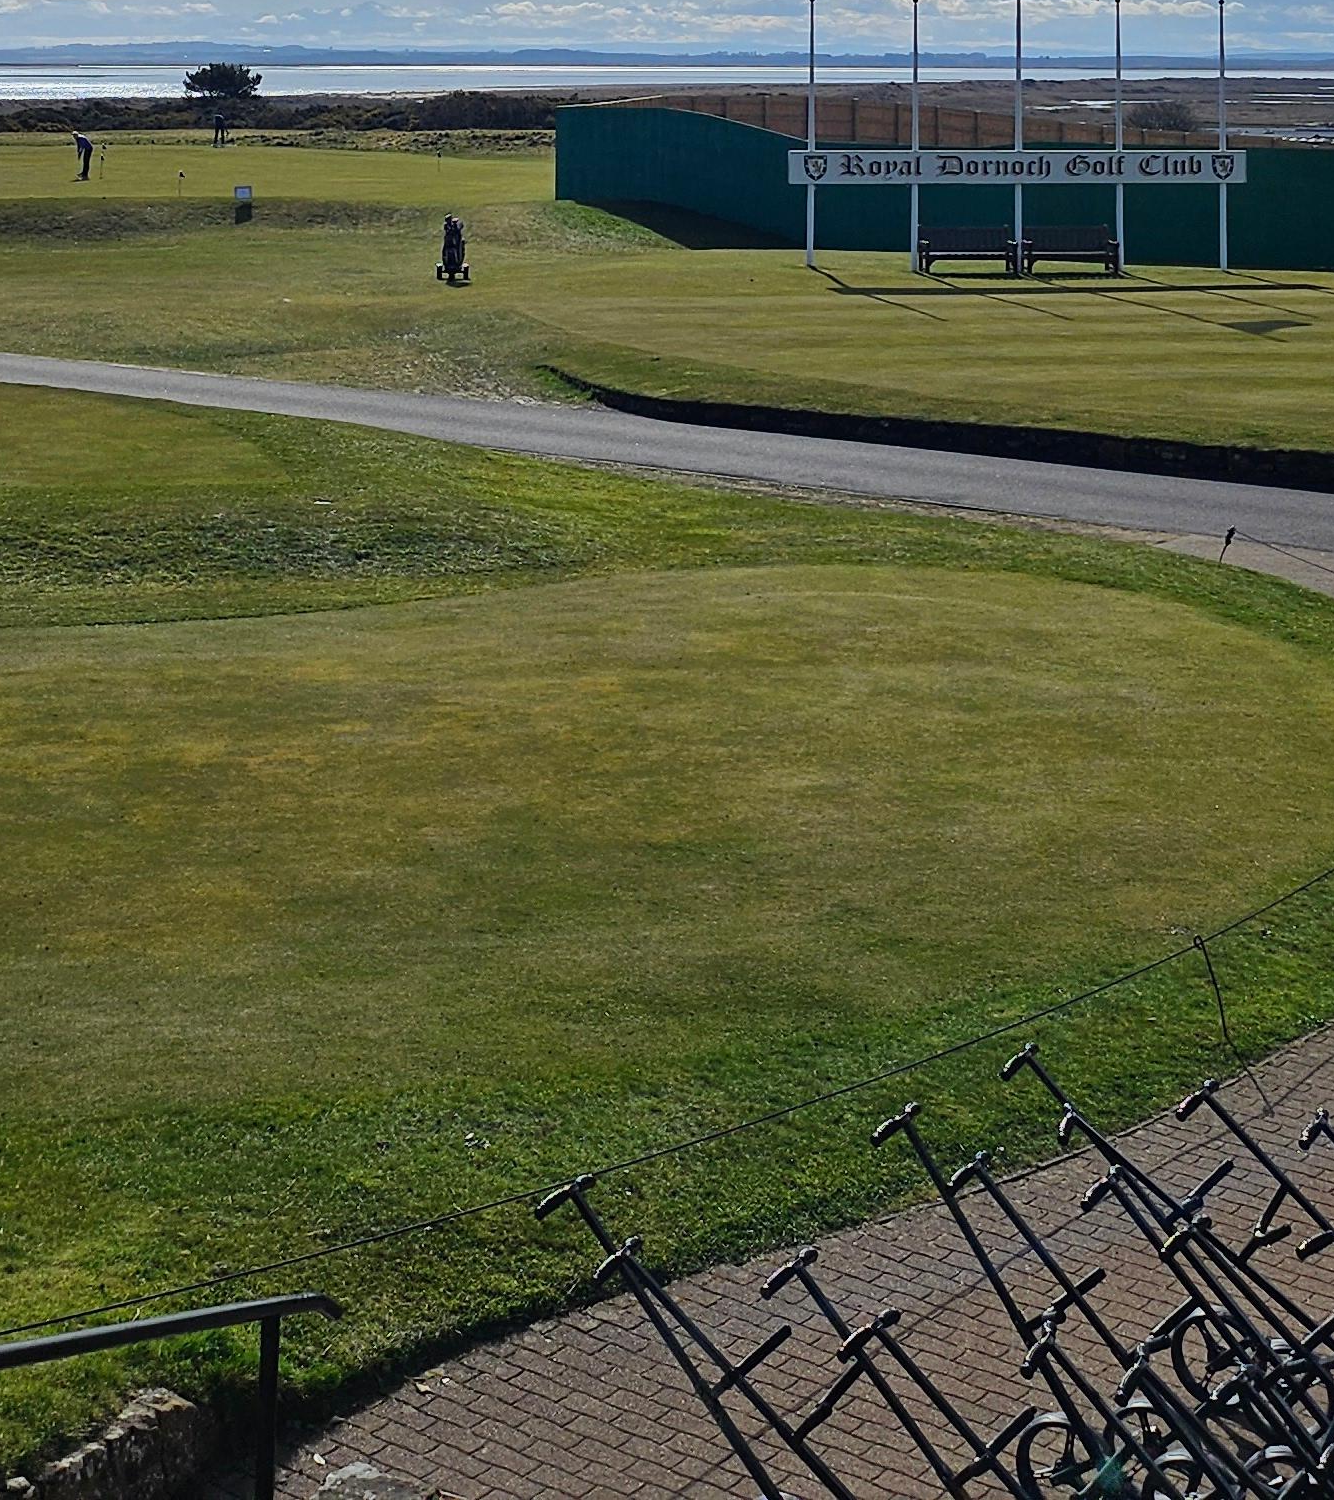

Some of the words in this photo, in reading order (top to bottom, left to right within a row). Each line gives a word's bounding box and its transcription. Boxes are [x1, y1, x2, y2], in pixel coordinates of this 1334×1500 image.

[840, 154, 923, 181] Royal
[936, 154, 1051, 179] Dornoch
[1065, 154, 1126, 177] Golf
[1139, 154, 1203, 177] Club
